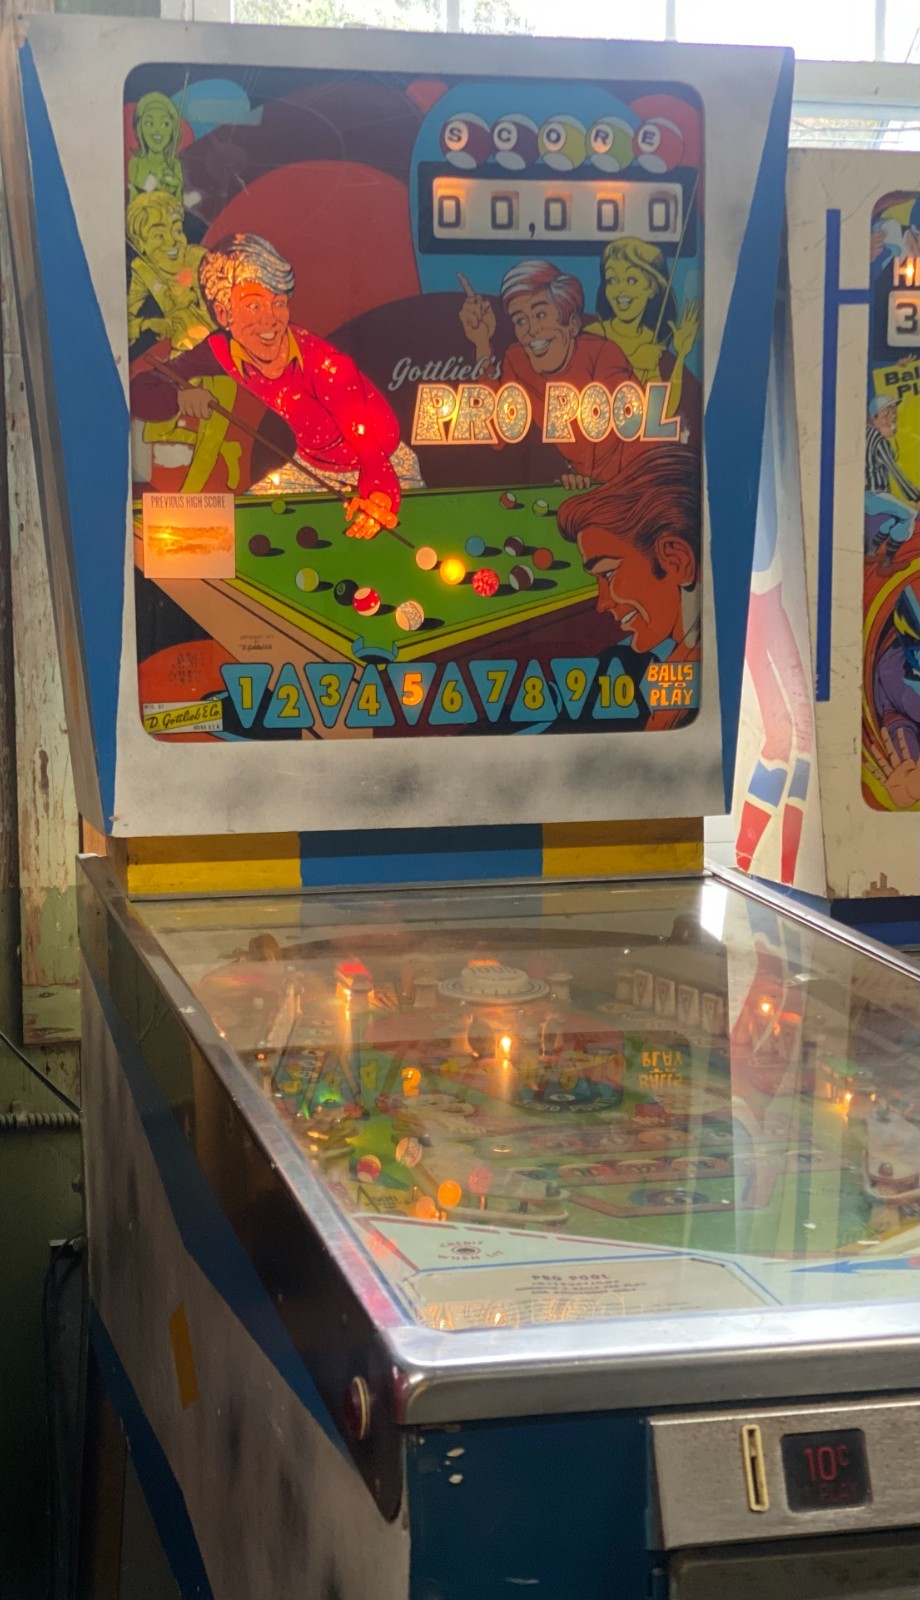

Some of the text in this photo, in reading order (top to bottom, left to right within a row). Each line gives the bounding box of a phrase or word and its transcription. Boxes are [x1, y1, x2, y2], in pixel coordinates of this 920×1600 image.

[388, 356, 502, 391] Gottlieb's
[411, 381, 681, 445] PRO POOL
[150, 495, 226, 509] PREVIOUS HIGH SCORE
[647, 664, 693, 681] BALLS
[238, 667, 635, 718] 1 2 3 4 5 6 7 8 9 10
[650, 689, 693, 706] PLAY
[162, 707, 201, 729] Gottlieb
